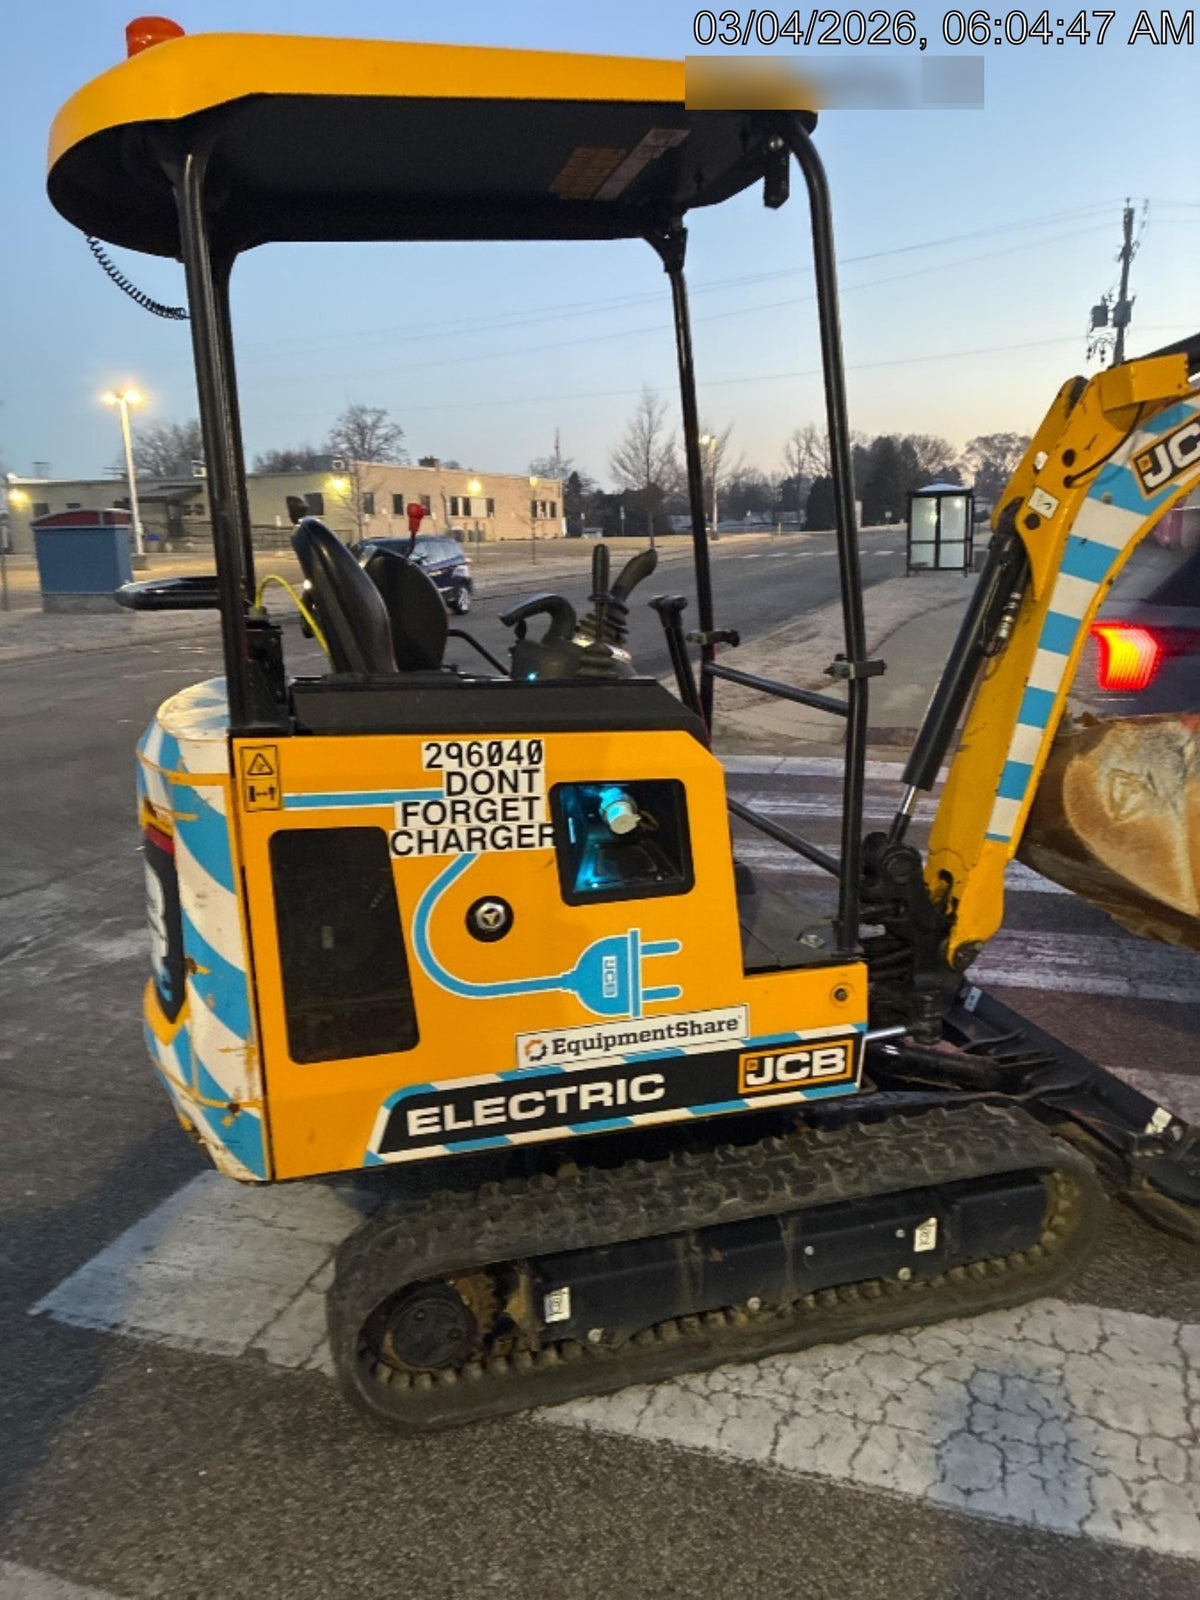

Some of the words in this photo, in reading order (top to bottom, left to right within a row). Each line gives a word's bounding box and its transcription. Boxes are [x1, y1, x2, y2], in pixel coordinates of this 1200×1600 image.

[424, 739, 543, 768] 296040
[445, 769, 540, 797] DONT
[401, 796, 541, 827] FORGET
[552, 1017, 739, 1056] EquipmentShare
[745, 1047, 846, 1086] JCB
[406, 1072, 666, 1137] ELECTRIC
